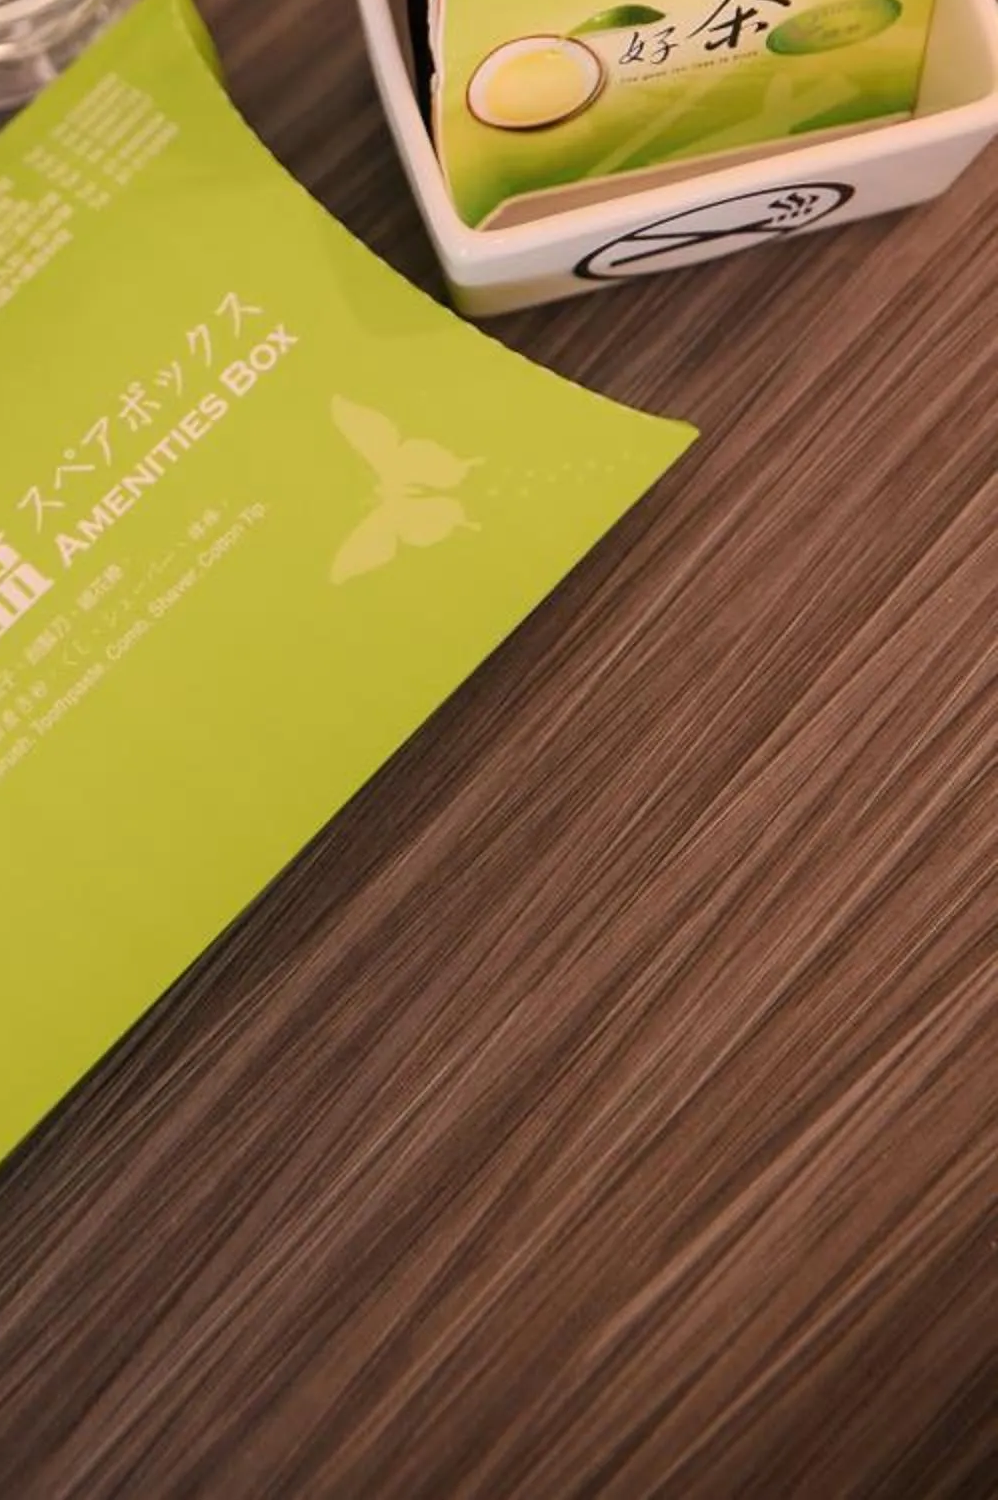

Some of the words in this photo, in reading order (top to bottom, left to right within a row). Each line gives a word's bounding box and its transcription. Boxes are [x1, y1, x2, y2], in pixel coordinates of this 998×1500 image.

[16, 290, 264, 535] スペアボックス
[53, 393, 229, 569] AMENITIES
